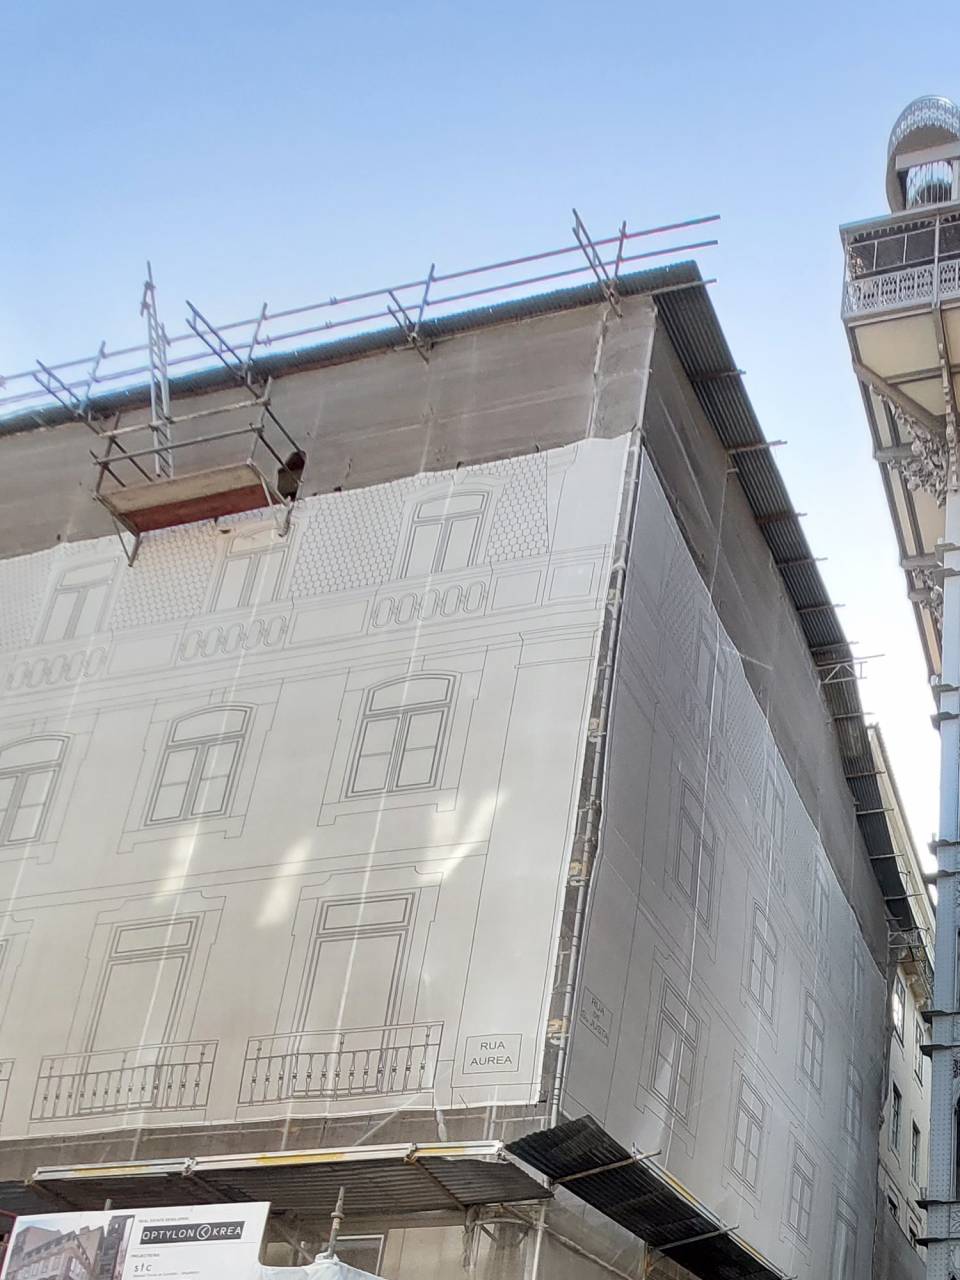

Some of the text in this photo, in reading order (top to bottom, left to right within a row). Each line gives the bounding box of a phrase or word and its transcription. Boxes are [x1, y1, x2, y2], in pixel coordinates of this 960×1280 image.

[480, 1041, 505, 1050] RUA
[470, 1055, 512, 1066] AUREA
[142, 1226, 242, 1240] OPTYLON KREA
